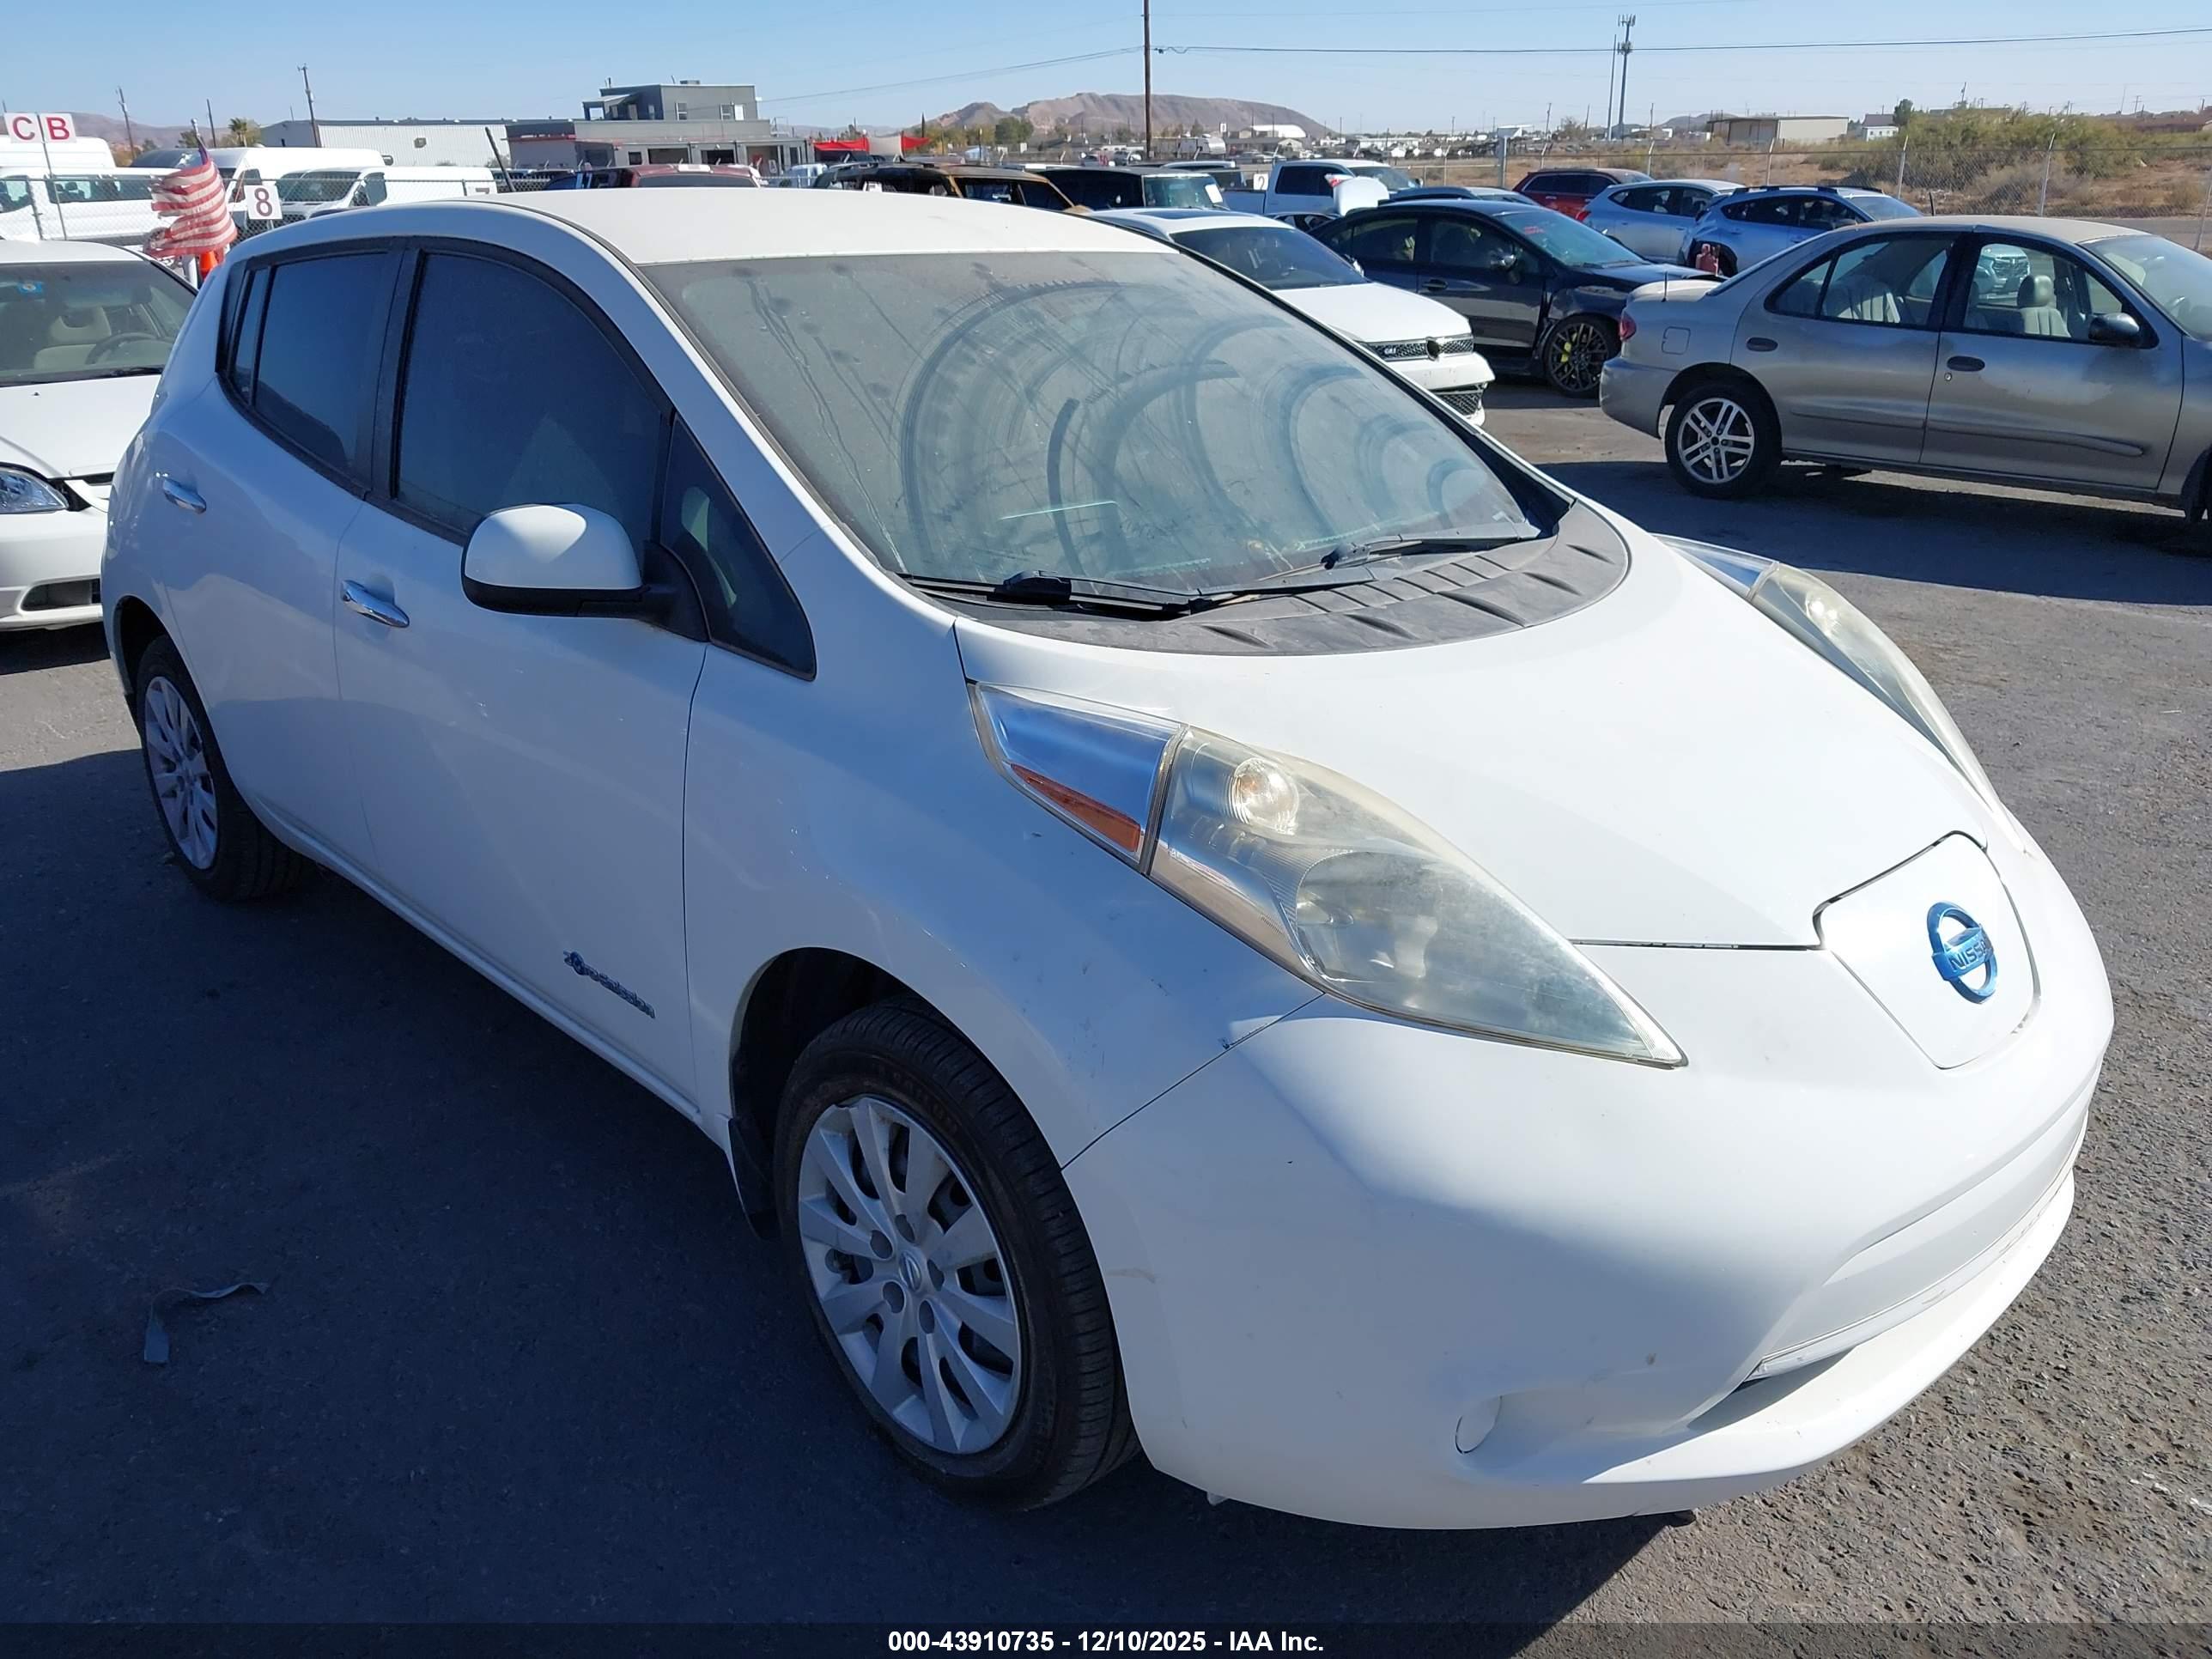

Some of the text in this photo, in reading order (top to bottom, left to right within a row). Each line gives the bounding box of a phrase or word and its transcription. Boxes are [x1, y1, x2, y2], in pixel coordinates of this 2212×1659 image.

[12, 116, 35, 141] C
[46, 116, 70, 140] B
[253, 187, 273, 217] 8
[1948, 939, 1987, 971] NISSA
